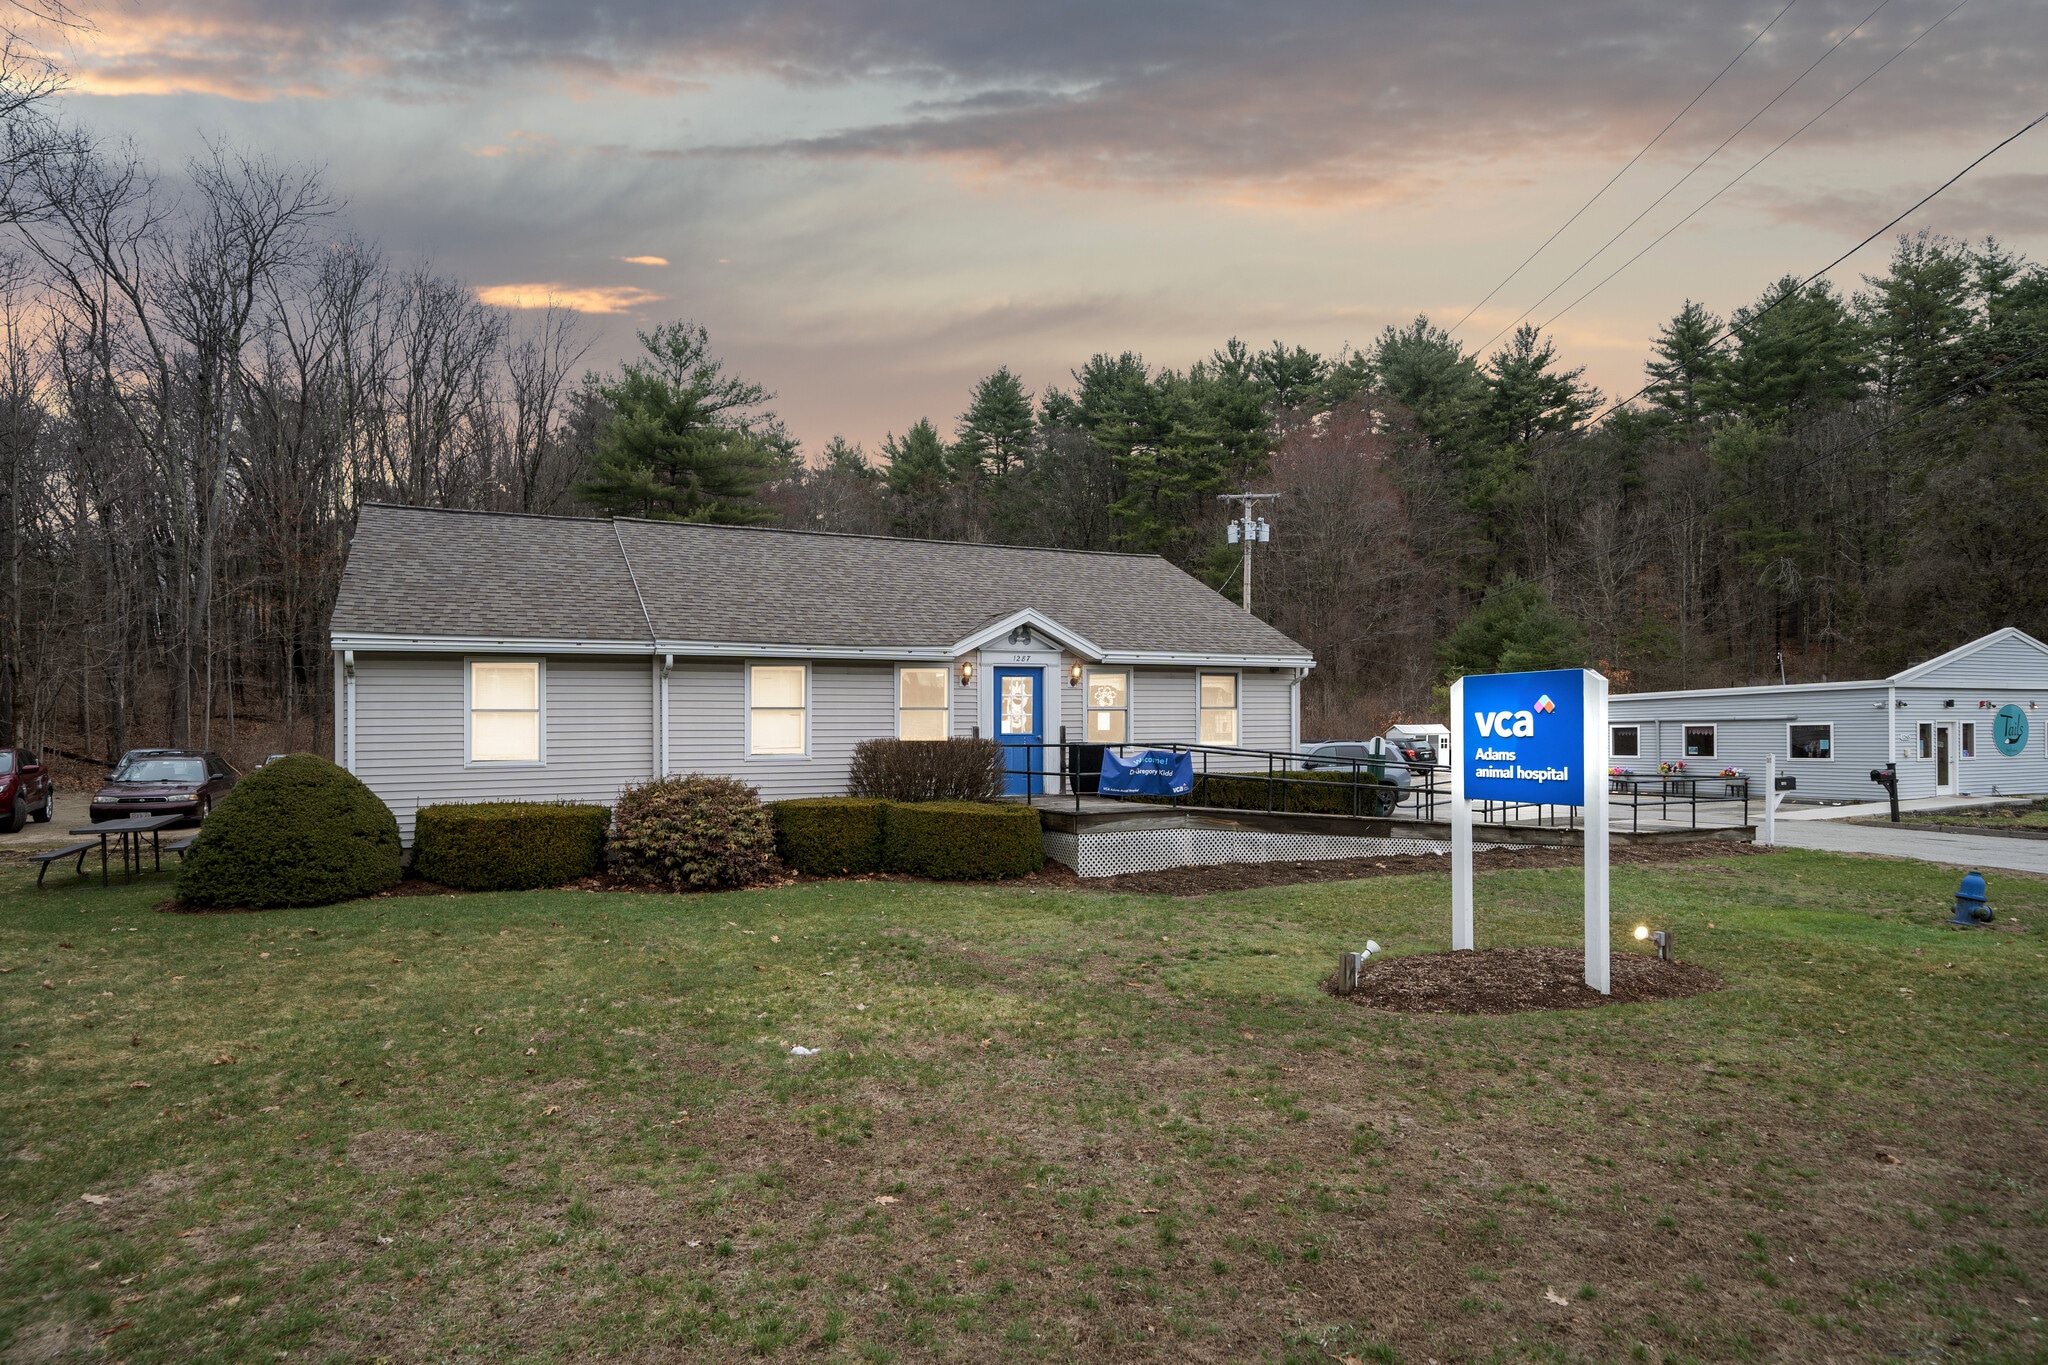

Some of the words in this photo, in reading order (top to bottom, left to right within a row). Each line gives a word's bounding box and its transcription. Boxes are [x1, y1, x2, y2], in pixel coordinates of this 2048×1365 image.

[1474, 710, 1534, 738] vca
[2000, 713, 2024, 737] Tails
[1475, 747, 1516, 761] Adams
[1159, 769, 1173, 777] Kidd
[1475, 765, 1514, 779] animal
[1516, 765, 1568, 783] hospital
[1172, 785, 1184, 793] vca
